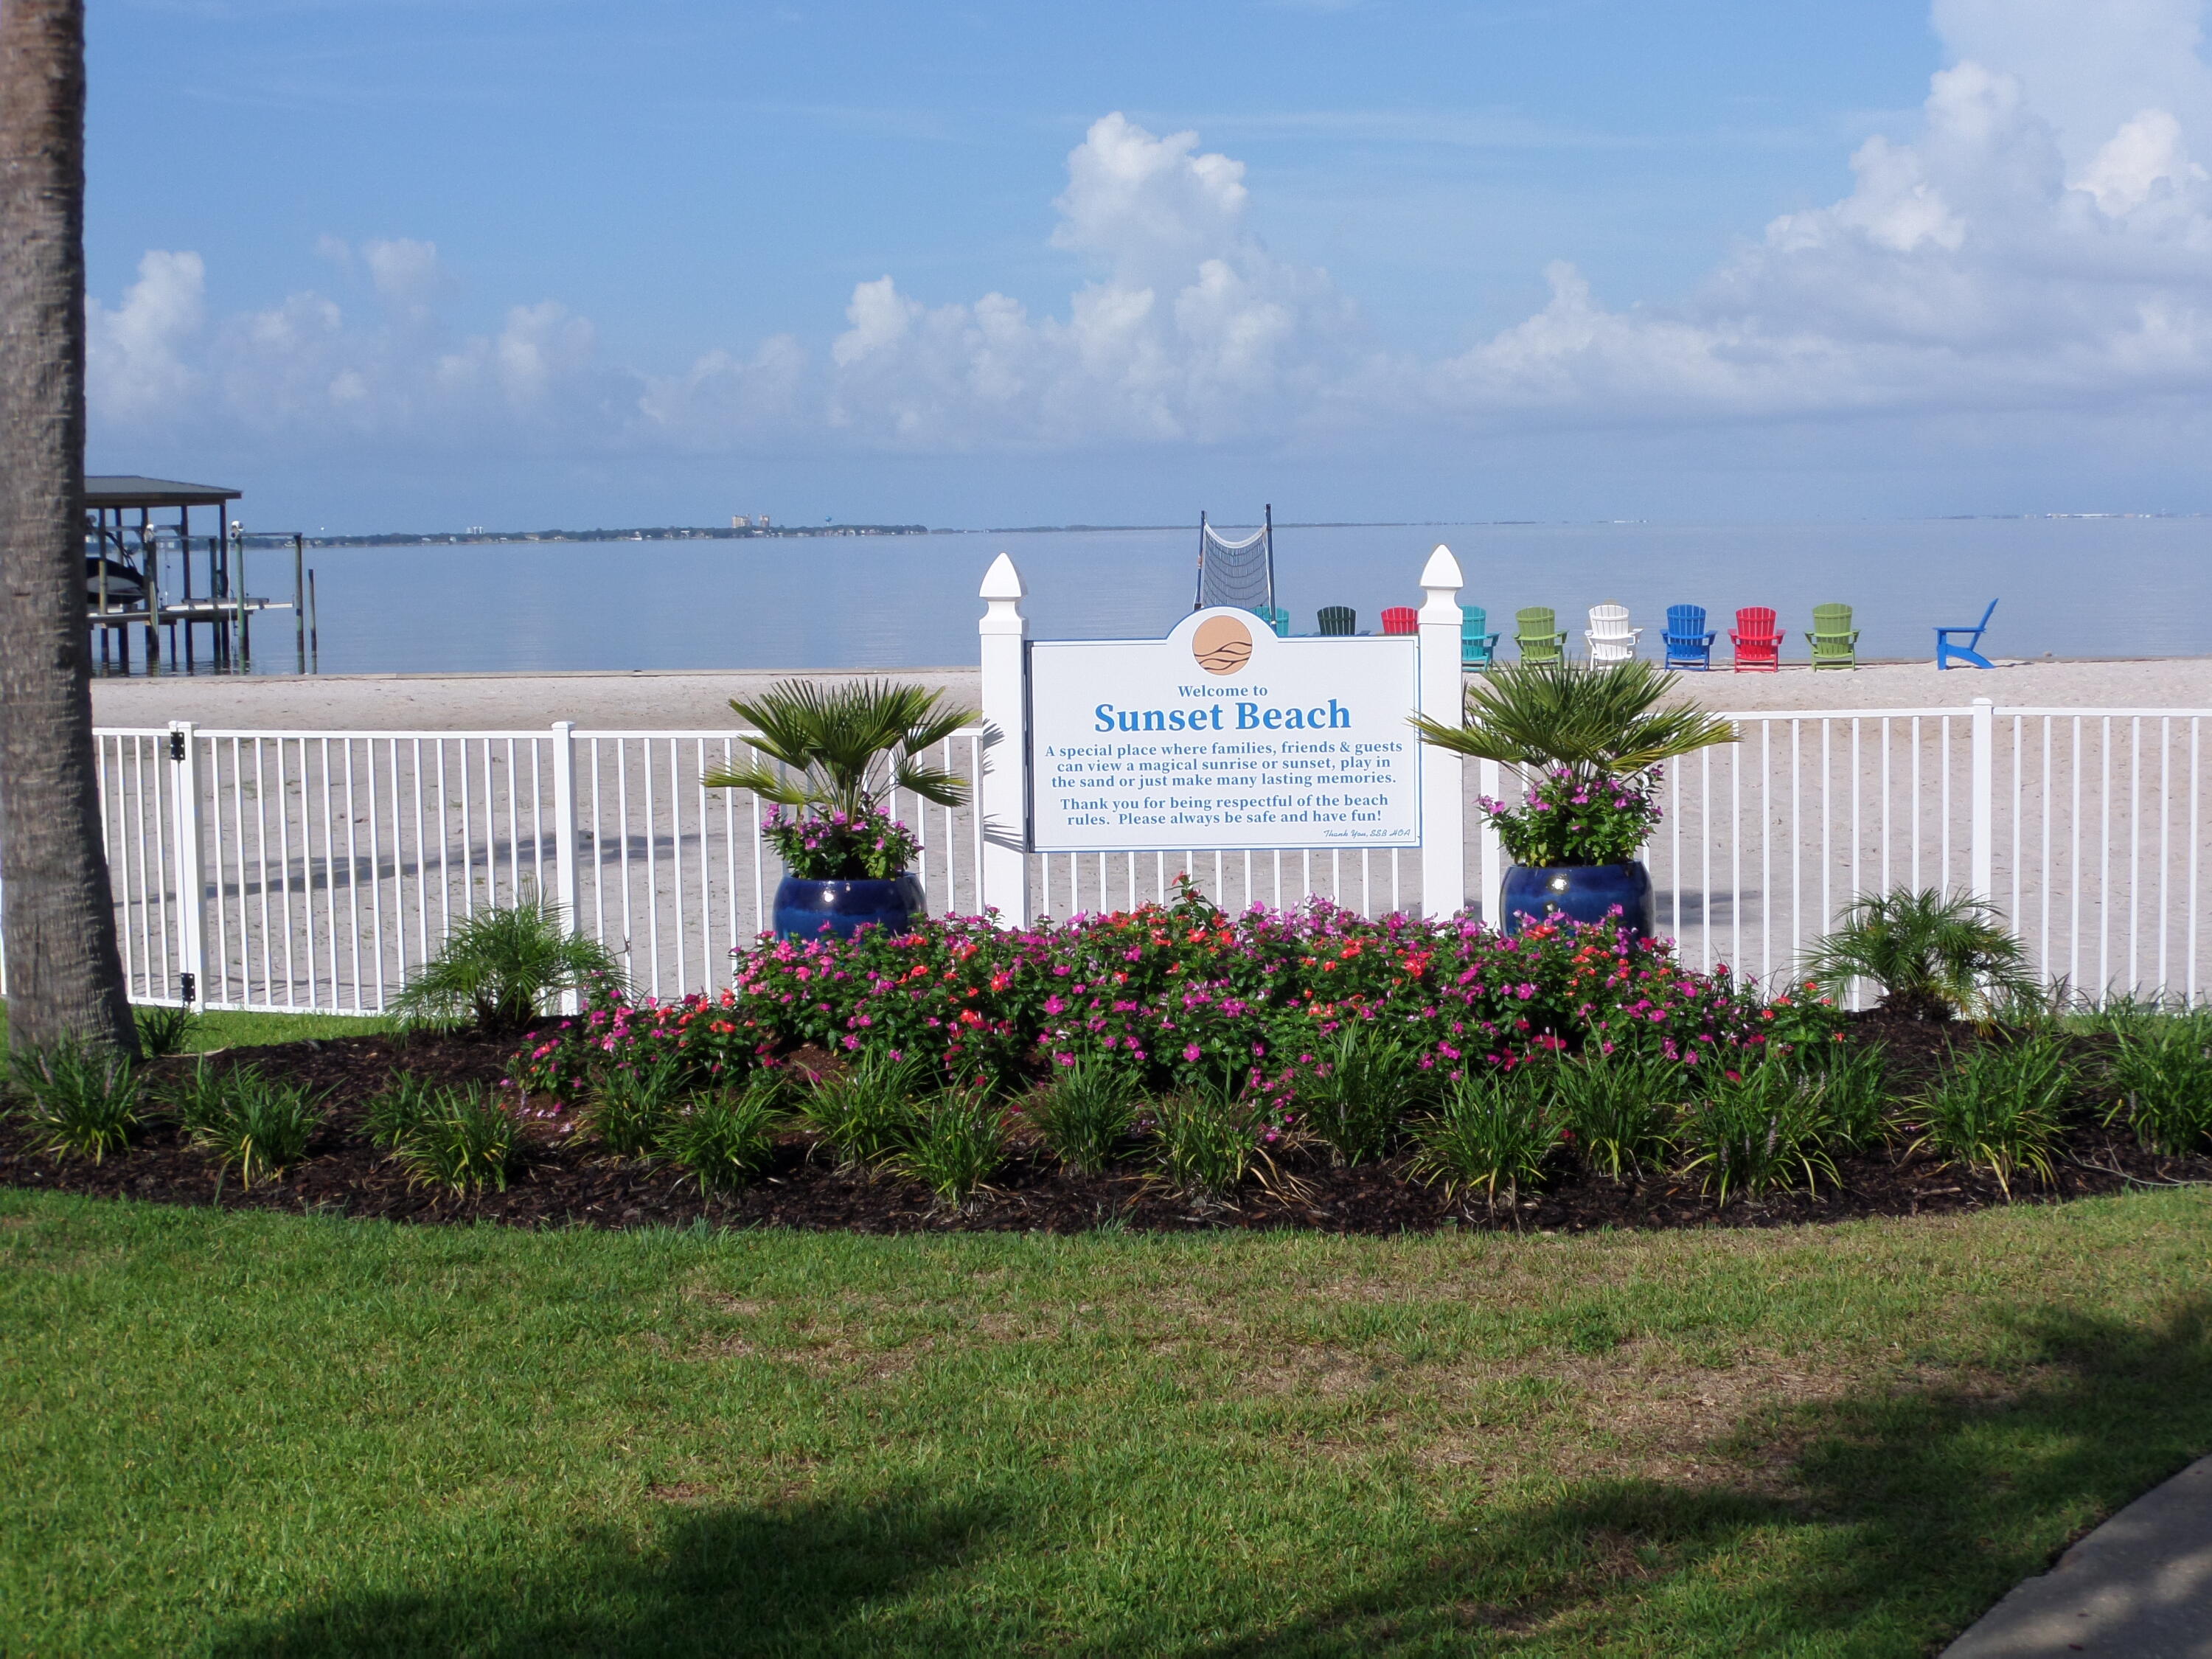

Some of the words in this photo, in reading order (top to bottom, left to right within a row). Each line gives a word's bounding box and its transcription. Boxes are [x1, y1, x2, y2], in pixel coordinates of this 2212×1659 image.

[1178, 684, 1248, 697] Welcome
[1253, 685, 1267, 696] to
[1095, 703, 1224, 732] Sunset
[1235, 698, 1352, 730] Beach
[1045, 745, 1055, 757] A
[1060, 744, 1112, 760] special
[1117, 743, 1156, 759] place
[1161, 743, 1207, 755] where
[1211, 742, 1276, 756] families,
[1281, 741, 1335, 753] friends
[1340, 741, 1350, 752] &
[1354, 742, 1402, 756] guests
[1057, 763, 1083, 772] can
[1088, 759, 1121, 771] view
[1127, 762, 1134, 771] a
[1139, 758, 1197, 774] magical
[1202, 757, 1257, 770] sunrise
[1262, 761, 1279, 769] or
[1282, 758, 1335, 771] sunset,
[1340, 756, 1371, 771] play
[1377, 756, 1390, 768] in
[1051, 776, 1075, 787] the
[1080, 775, 1114, 787] sand
[1119, 778, 1135, 787] or
[1138, 774, 1167, 790] just
[1172, 773, 1212, 786] make
[1217, 776, 1257, 788] many
[1262, 772, 1312, 787] lasting
[1317, 771, 1396, 784] memories.
[1060, 798, 1108, 810] Thank
[1112, 801, 1139, 813] you
[1144, 796, 1166, 809] for
[1170, 796, 1212, 811] being
[1217, 795, 1292, 810] respectful
[1297, 794, 1313, 807] of
[1315, 794, 1339, 807] the
[1344, 793, 1388, 806] beach
[1068, 813, 1110, 825] rules.
[1119, 813, 1166, 824] Please
[1170, 812, 1220, 827] always
[1225, 811, 1242, 823] be
[1247, 810, 1276, 823] safe
[1281, 810, 1308, 822] and
[1312, 810, 1346, 822] have
[1352, 809, 1380, 821] fun!
[1324, 829, 1349, 838] Thank
